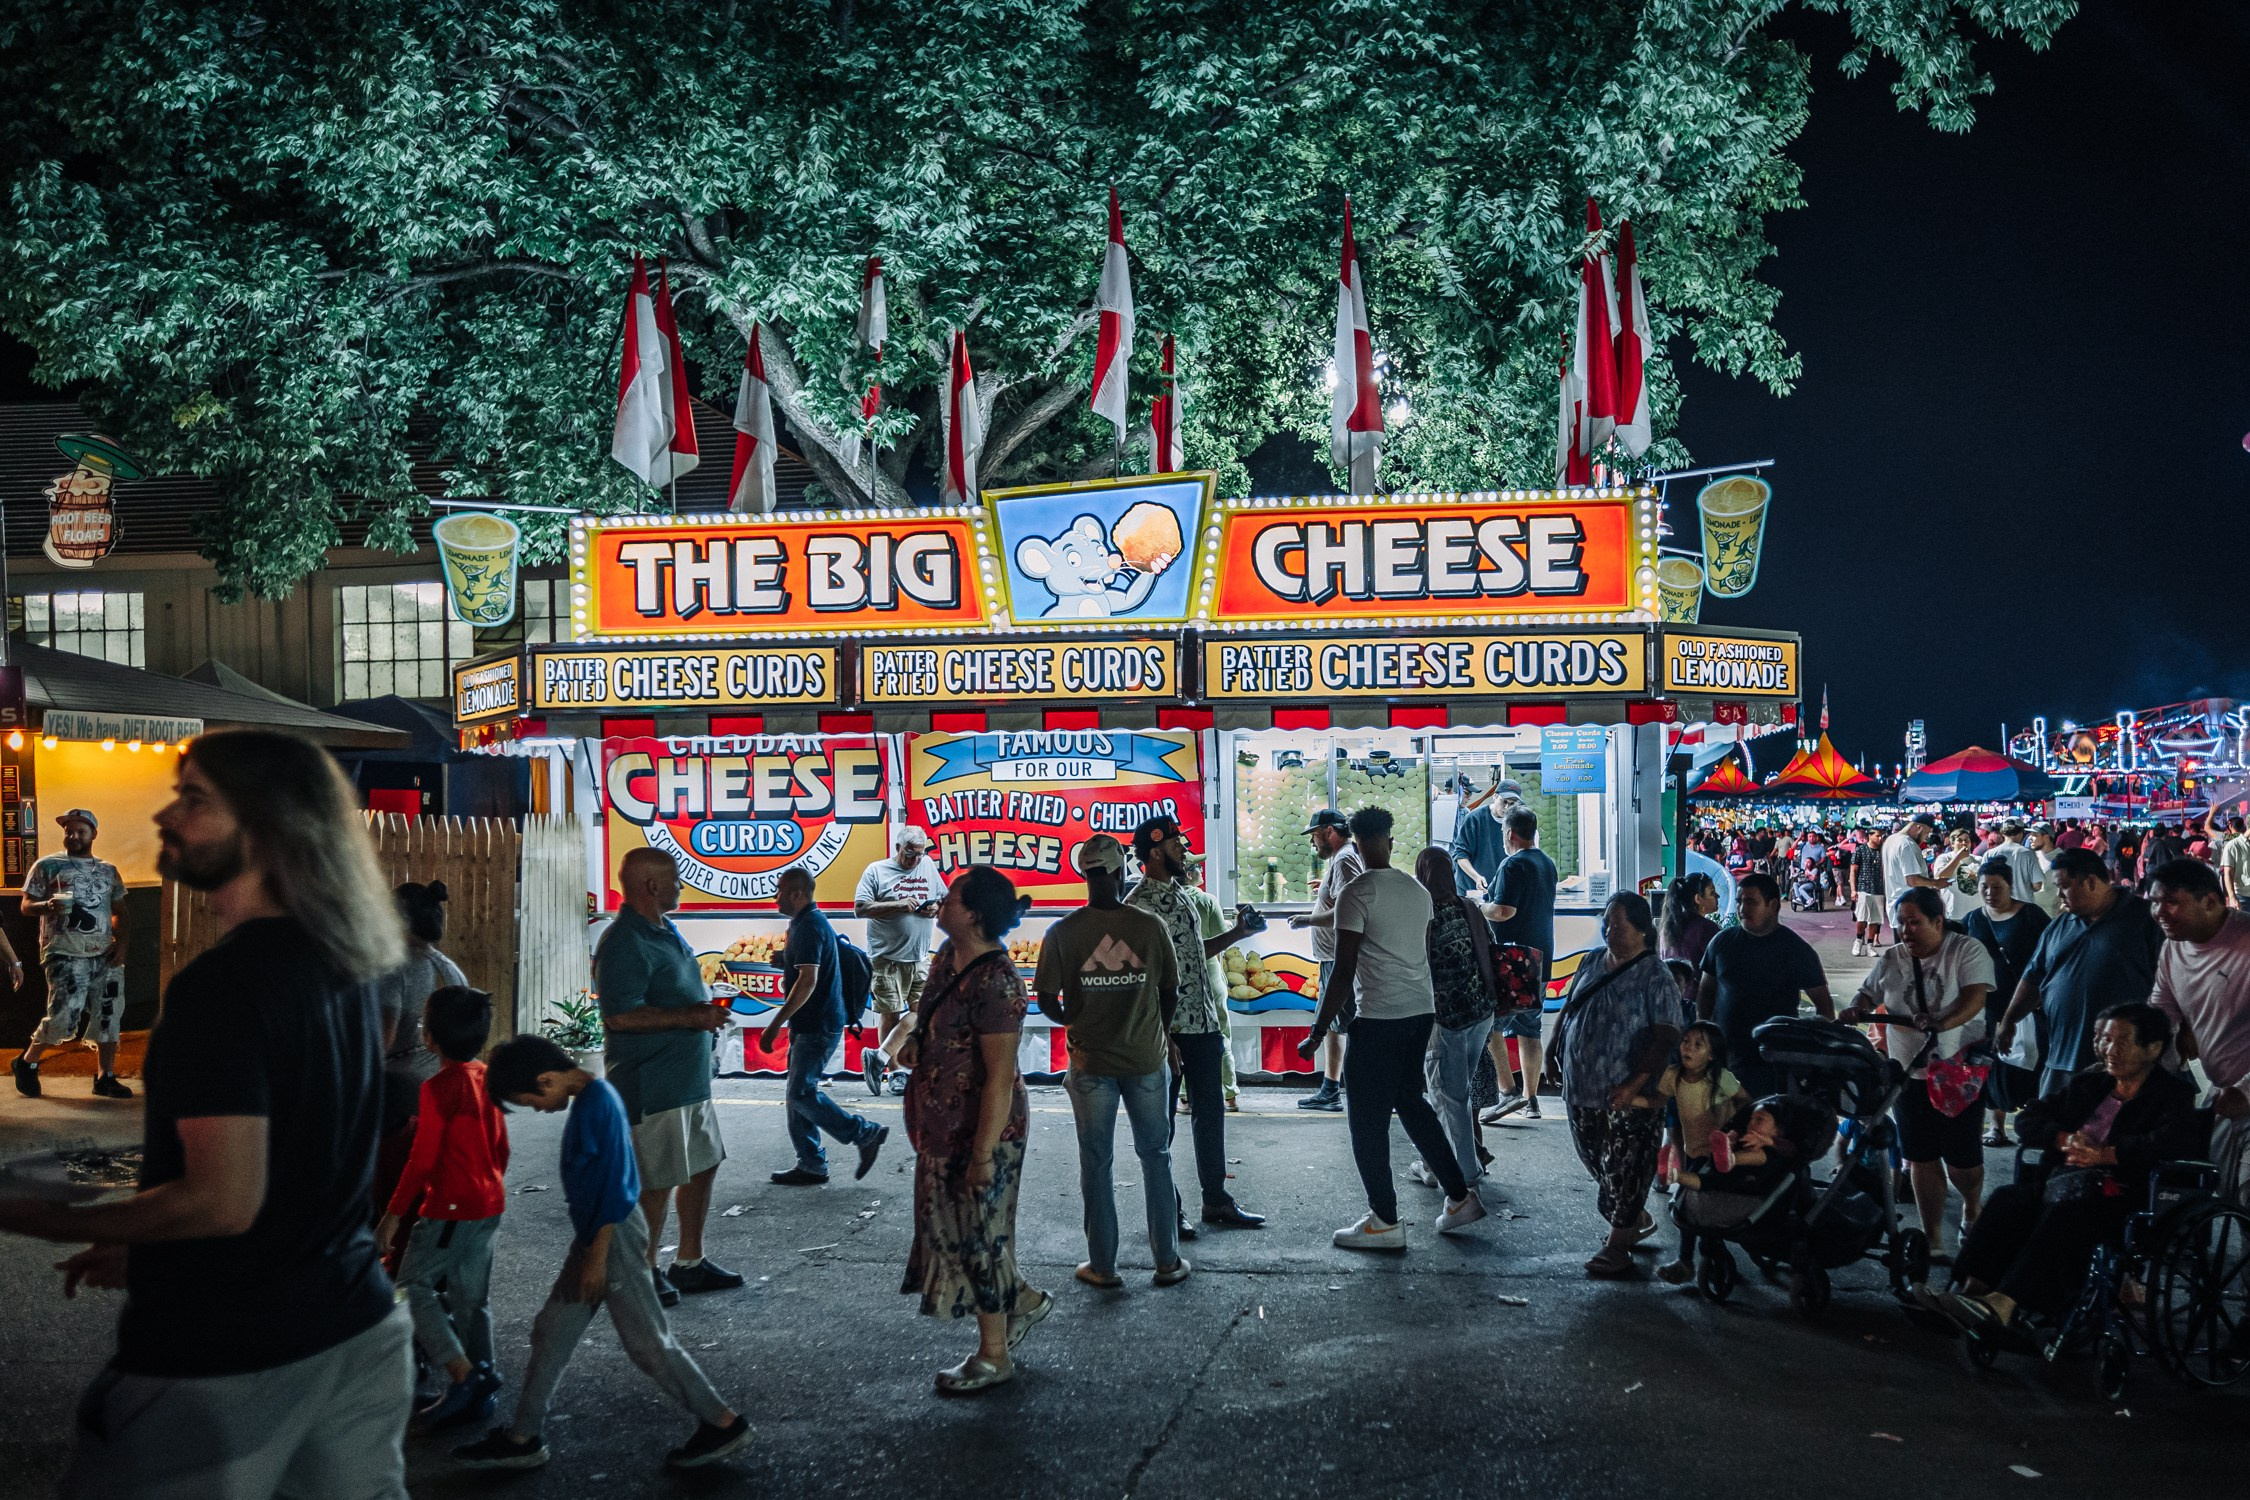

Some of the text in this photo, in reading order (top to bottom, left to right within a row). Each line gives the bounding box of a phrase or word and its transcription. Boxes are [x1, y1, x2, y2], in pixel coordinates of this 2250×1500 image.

[51, 511, 112, 525] ROOT BEER
[1704, 514, 1740, 529] LEMONADE
[63, 529, 104, 542] FLOATS
[444, 546, 490, 562] LEMONADE
[1252, 514, 1588, 605] CHEESE
[619, 532, 959, 619] THE BIG
[873, 651, 938, 673] BATTER
[1222, 645, 1312, 669] BATTER
[1679, 640, 1782, 662] OLD FASHIONED
[545, 658, 606, 680] BATTER
[944, 646, 1165, 692] CHEESE CURDS
[1320, 640, 1627, 688] CHEESE CURDS
[1671, 658, 1788, 689] LEMONADE
[463, 664, 512, 689] OLD FASHIONED
[613, 654, 825, 699] CHEESE CURDS
[873, 673, 938, 695] FRIED
[1222, 668, 1312, 691] FRIED
[461, 680, 516, 715] LEMONADE
[545, 680, 606, 701] FRIED
[47, 714, 74, 736] YES!
[77, 715, 93, 737] We
[96, 717, 120, 740] have
[124, 719, 147, 740] DIET
[149, 719, 175, 742] ROOT
[998, 733, 1114, 757] FAMOUS
[1015, 762, 1092, 777] FOR OUR
[606, 749, 887, 826] CHEESE
[924, 789, 1002, 826] BATTER
[1007, 790, 1067, 827] FRIED
[700, 823, 796, 853] CURDS
[816, 831, 845, 860] INC.
[724, 973, 774, 993] HEESE
[1080, 972, 1147, 986] waucoba
